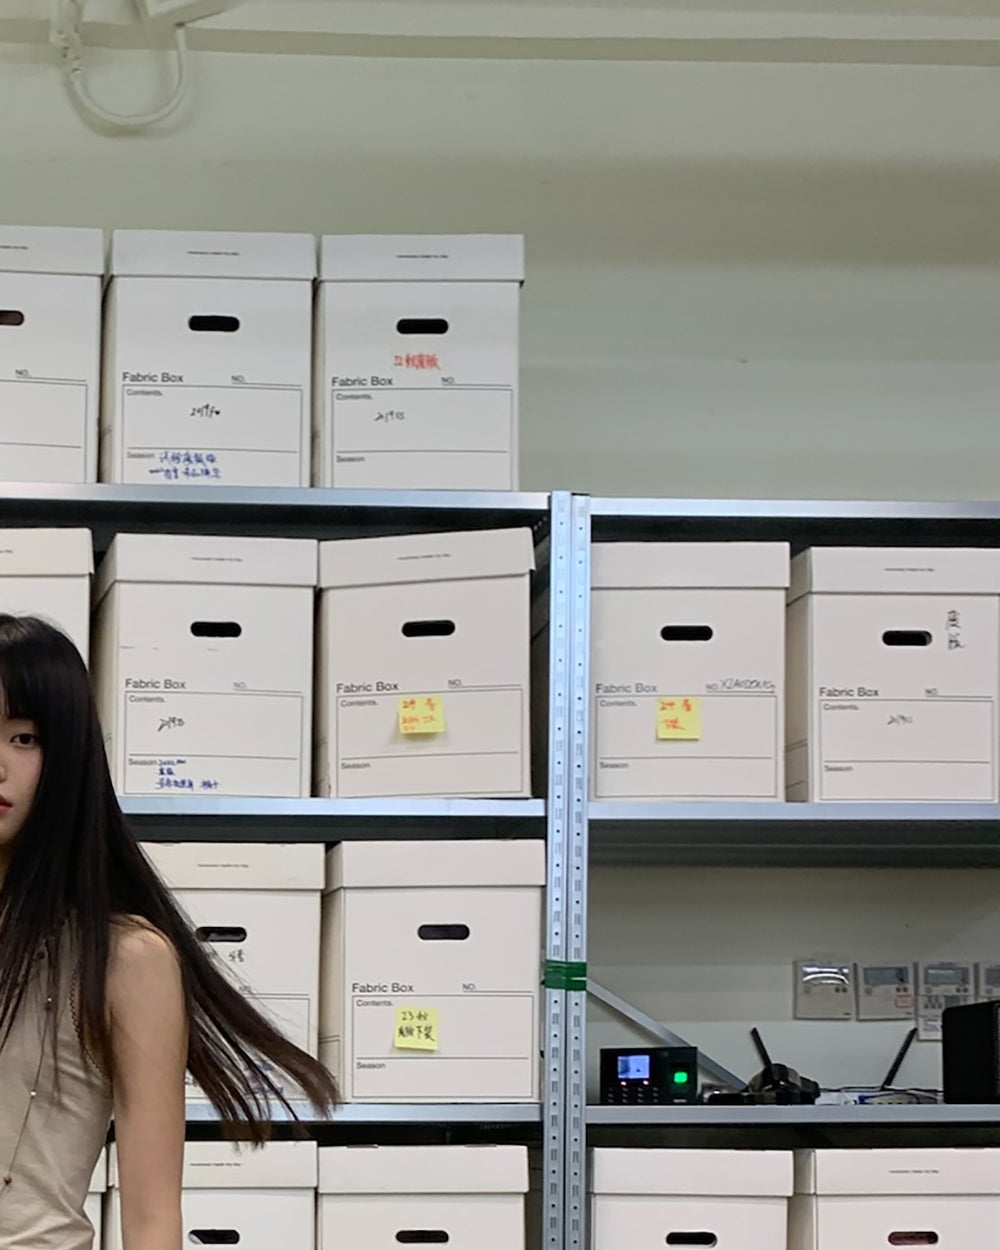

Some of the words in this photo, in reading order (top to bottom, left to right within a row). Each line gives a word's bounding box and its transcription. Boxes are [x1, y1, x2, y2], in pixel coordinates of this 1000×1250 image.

[122, 372, 158, 383] Fabric
[161, 373, 184, 382] Box
[332, 377, 367, 387] Fabric
[371, 376, 394, 386] Box
[125, 678, 161, 689] Fabric
[164, 679, 186, 689] Box
[336, 683, 373, 694] Fabric
[376, 682, 399, 692] Box
[596, 683, 632, 693] Fabric
[635, 683, 657, 693] Box
[819, 687, 855, 697] Fabric
[857, 687, 879, 697] Box
[352, 983, 388, 993] Fabric
[391, 983, 414, 993] Box
[356, 999, 393, 1007] Contents.
